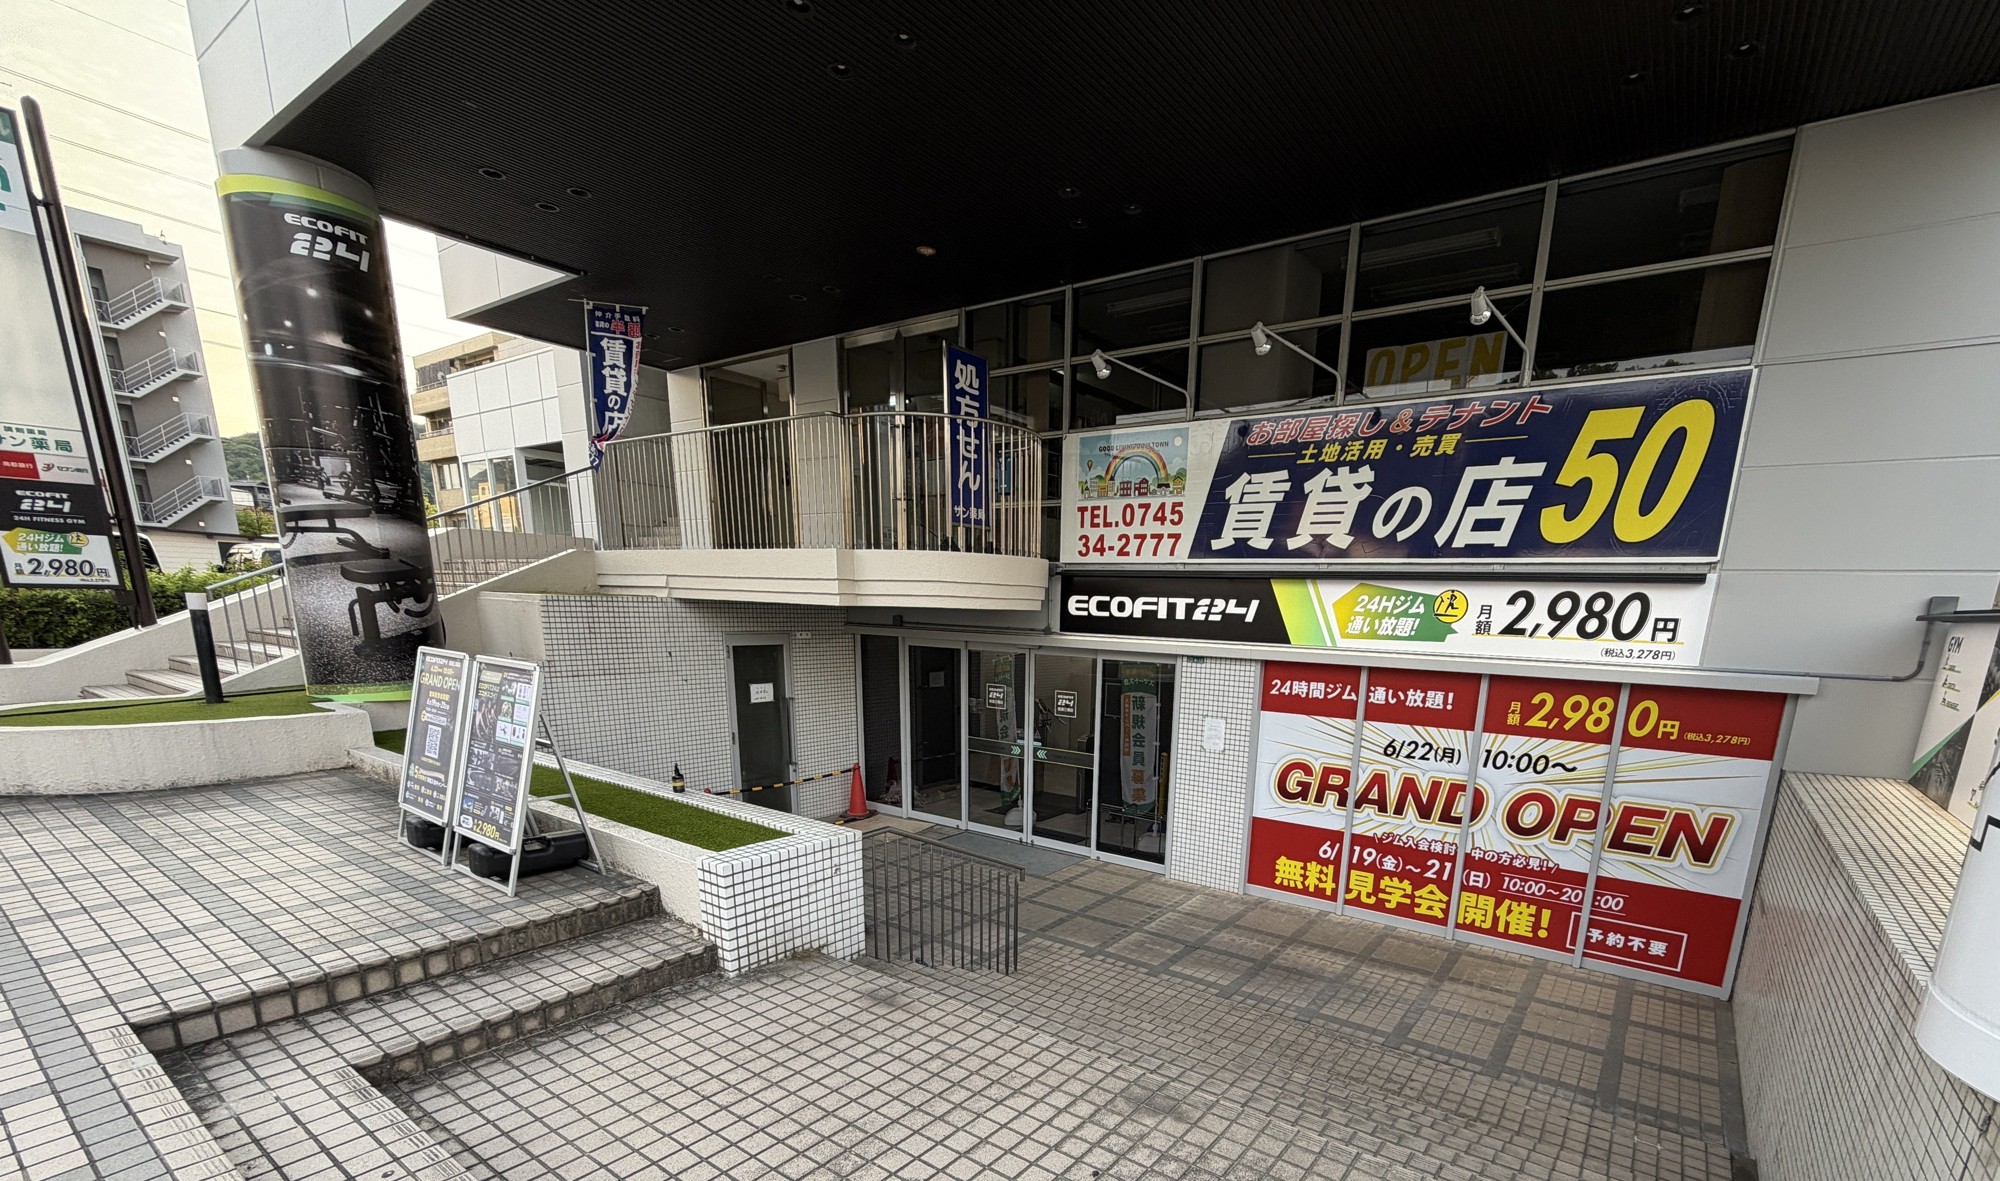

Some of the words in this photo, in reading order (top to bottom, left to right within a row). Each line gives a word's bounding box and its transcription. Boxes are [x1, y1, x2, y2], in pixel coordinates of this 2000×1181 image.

[283, 212, 368, 245] ECOFIT
[290, 232, 370, 272] 24
[1367, 332, 1505, 387] OPEN
[954, 359, 980, 491] 処方せん
[1296, 433, 1463, 464] 土地活用・売買
[1210, 456, 1548, 551] 賃貸の店
[1539, 399, 1716, 545] 50
[15, 490, 70, 499] ECOFIT
[20, 499, 71, 513] 24
[32, 516, 65, 524] FITNESS
[1077, 502, 1184, 529] TEL.0745
[18, 533, 65, 543] 24Hジム
[1077, 533, 1182, 558] 34-2777
[27, 558, 110, 578] 2,980円
[1353, 595, 1425, 615] 24Hジム
[1475, 604, 1493, 635] 月額
[1497, 589, 1681, 643] 2,980円
[1345, 616, 1420, 637] 通い放題!
[1600, 647, 1676, 661] (税込3,278円)
[420, 672, 442, 688] GRAND
[1270, 679, 1358, 701] 24時間ジム
[1368, 686, 1454, 710] 通い放題!
[1507, 701, 1521, 726] 月額
[1383, 738, 1461, 765] 6/22(月)
[1683, 732, 1751, 746] (税込3,278円)
[1275, 759, 1487, 828] GRAND
[1504, 789, 1733, 866] OPEN
[1587, 928, 1668, 957] 予約不要
